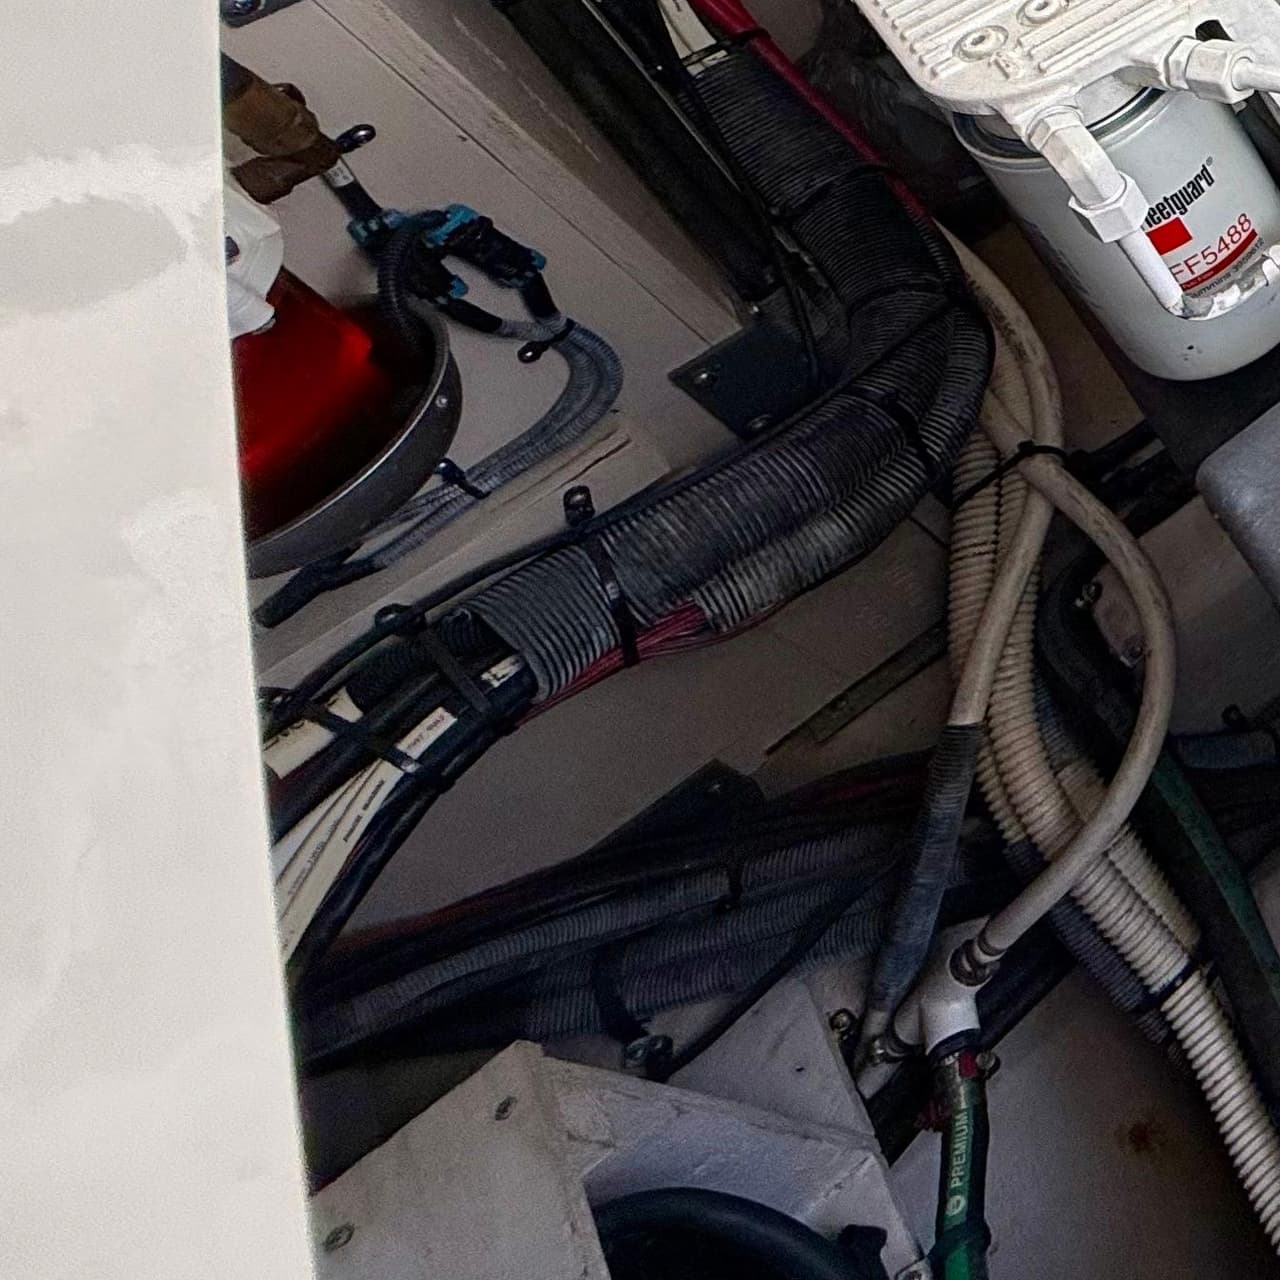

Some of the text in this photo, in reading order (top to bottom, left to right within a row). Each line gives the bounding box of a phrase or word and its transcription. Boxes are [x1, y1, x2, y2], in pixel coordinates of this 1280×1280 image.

[1144, 165, 1214, 228] leetguard
[1169, 212, 1252, 283] FF5488
[950, 1109, 969, 1189] PREMIUM
